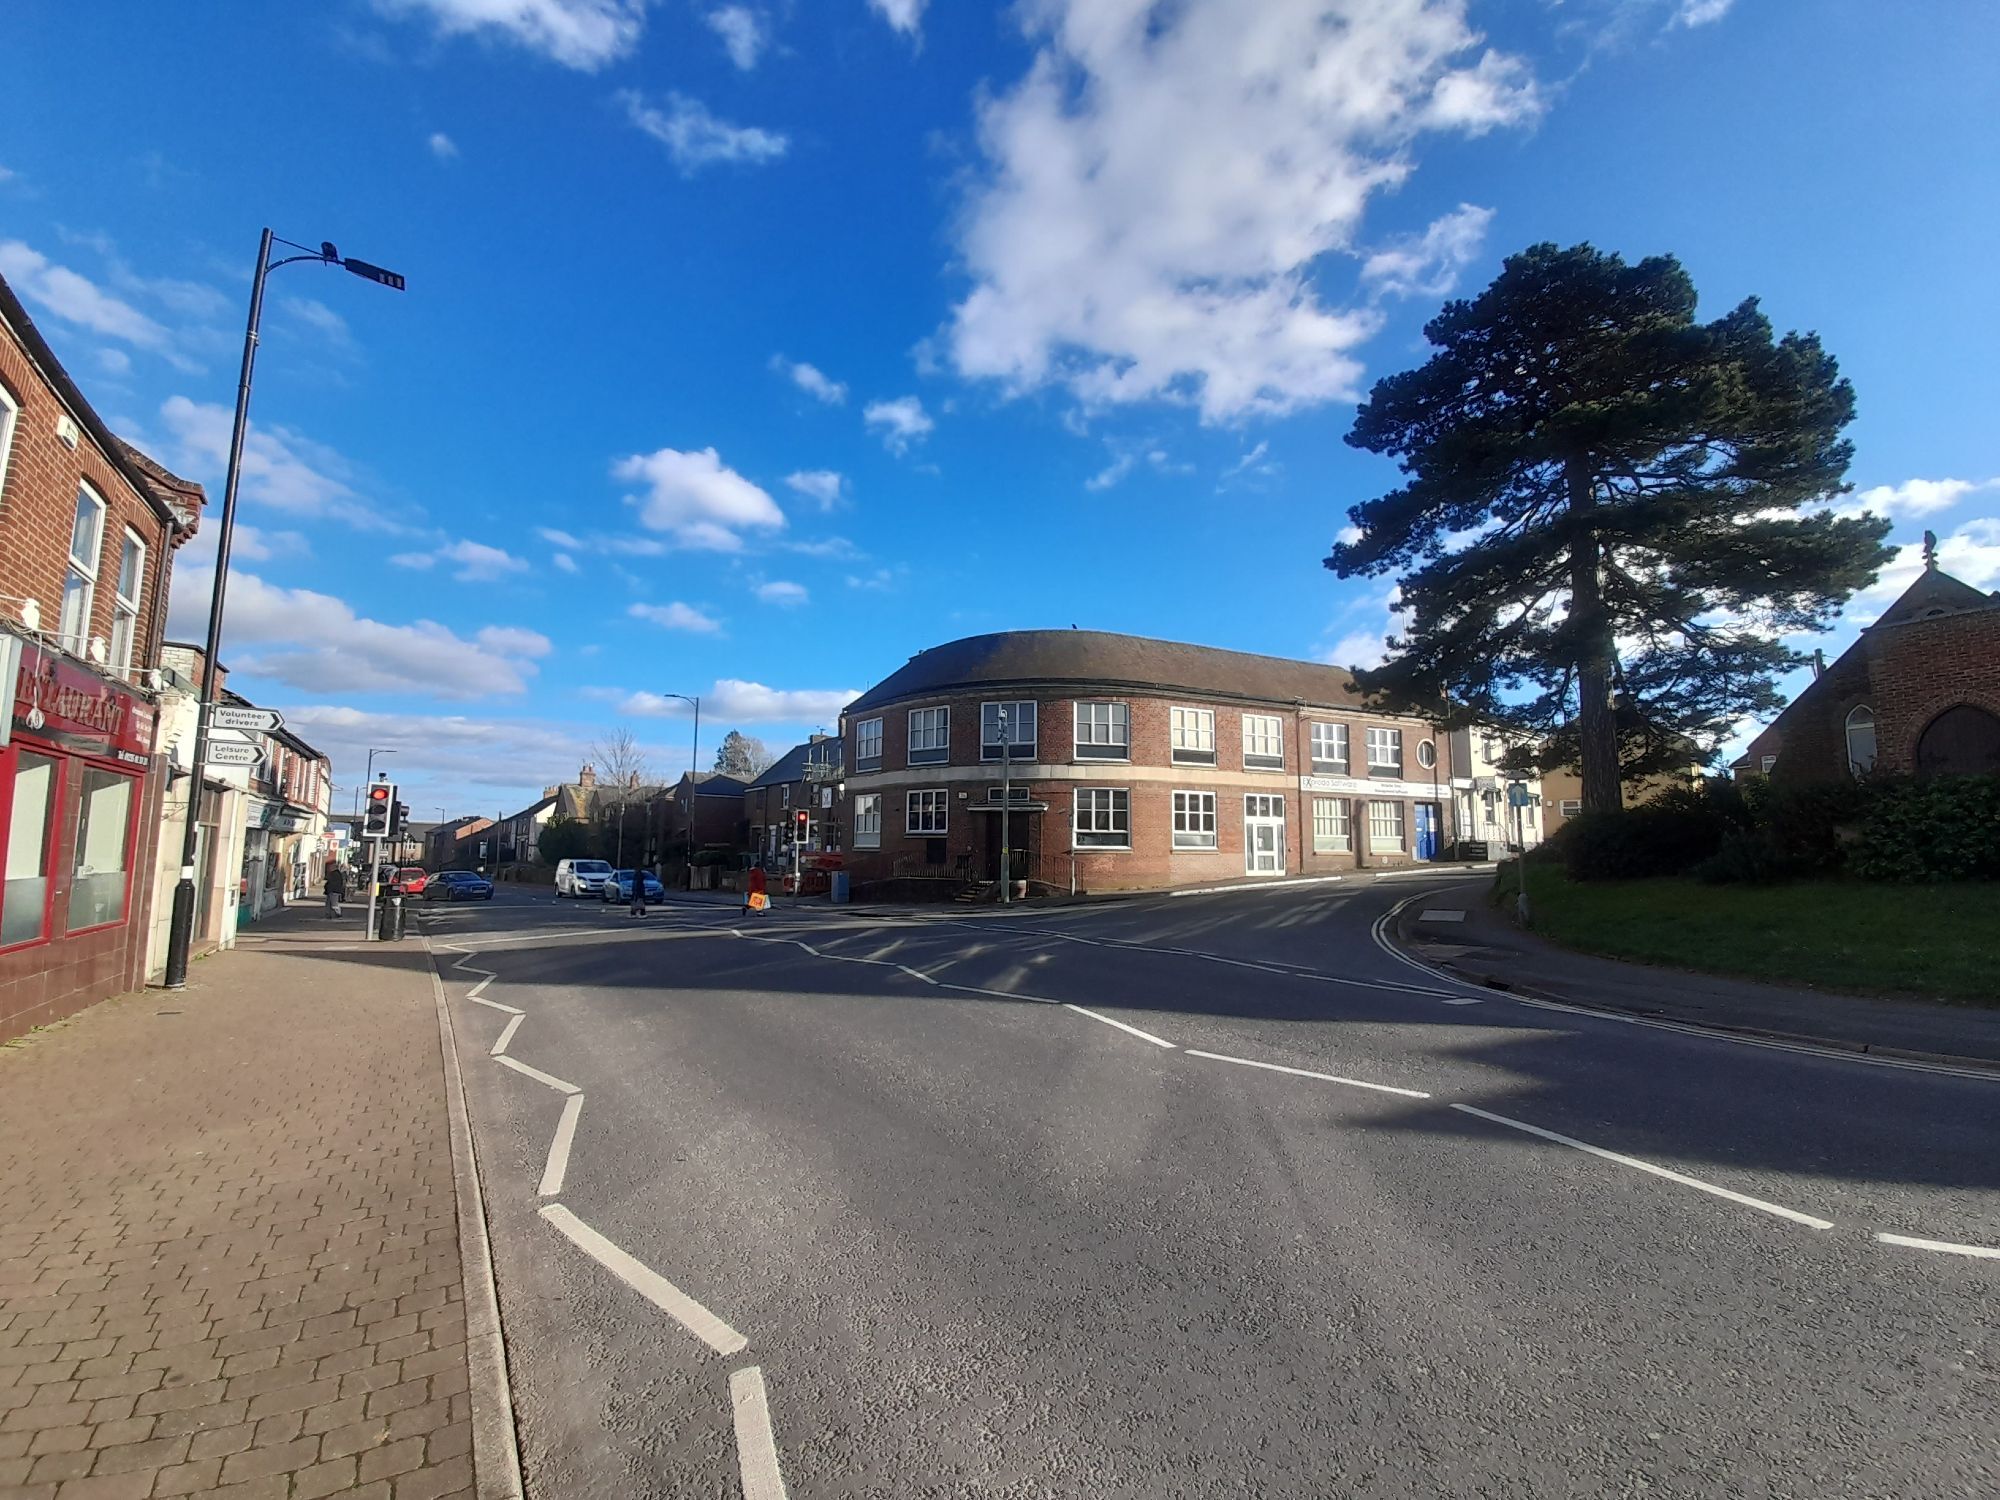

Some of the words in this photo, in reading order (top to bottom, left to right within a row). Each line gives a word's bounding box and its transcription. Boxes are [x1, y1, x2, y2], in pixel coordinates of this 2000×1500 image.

[15, 666, 124, 735] ESTAURANT
[219, 709, 266, 719] Volunteer
[215, 745, 249, 753] Leisure
